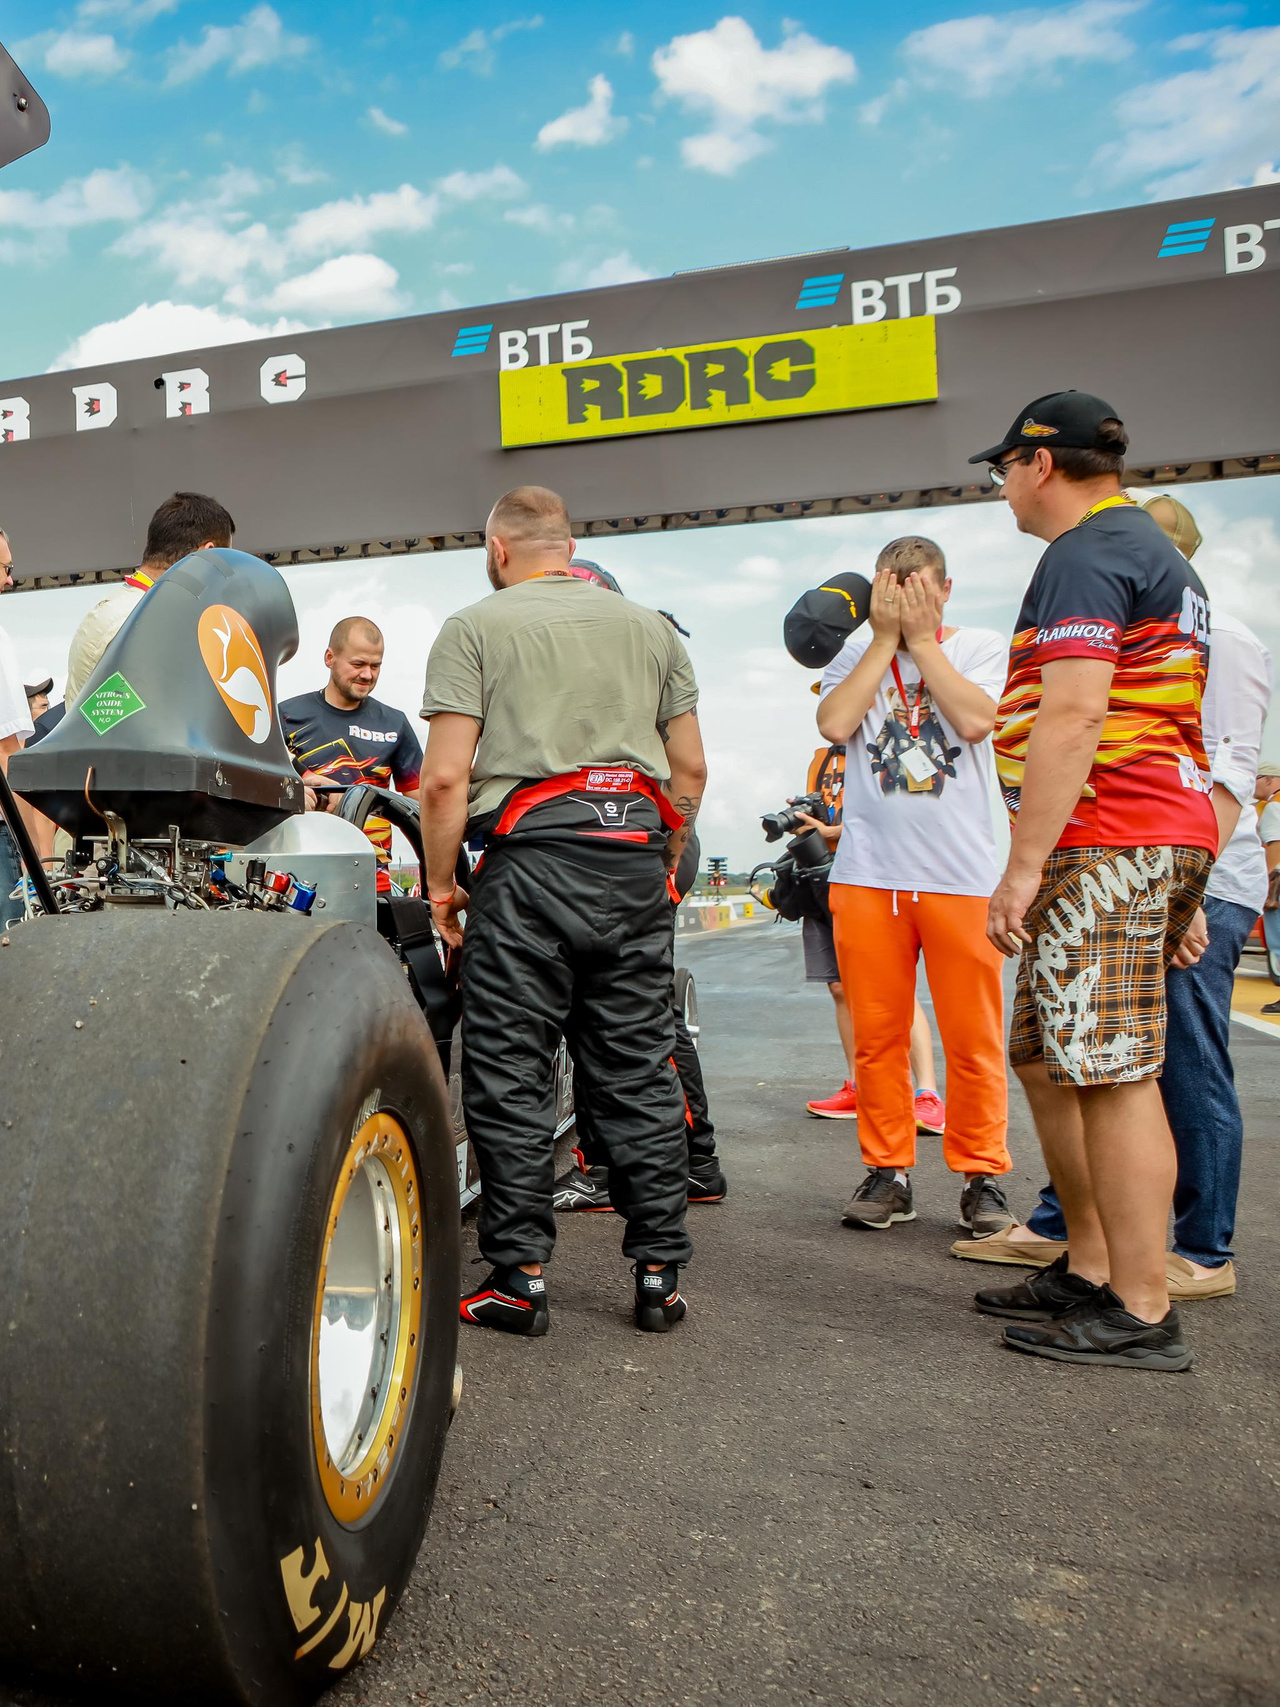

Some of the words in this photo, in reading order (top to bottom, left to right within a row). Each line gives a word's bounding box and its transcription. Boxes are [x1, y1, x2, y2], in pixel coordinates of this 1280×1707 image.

[850, 267, 962, 325] ВТБ
[498, 319, 594, 371] ВТБ
[560, 338, 816, 425] RDRC
[1035, 624, 1117, 646] FLAMHOLC
[91, 708, 124, 716] SYSTEM
[348, 724, 399, 744] RDRC
[643, 1277, 663, 1286] OMP
